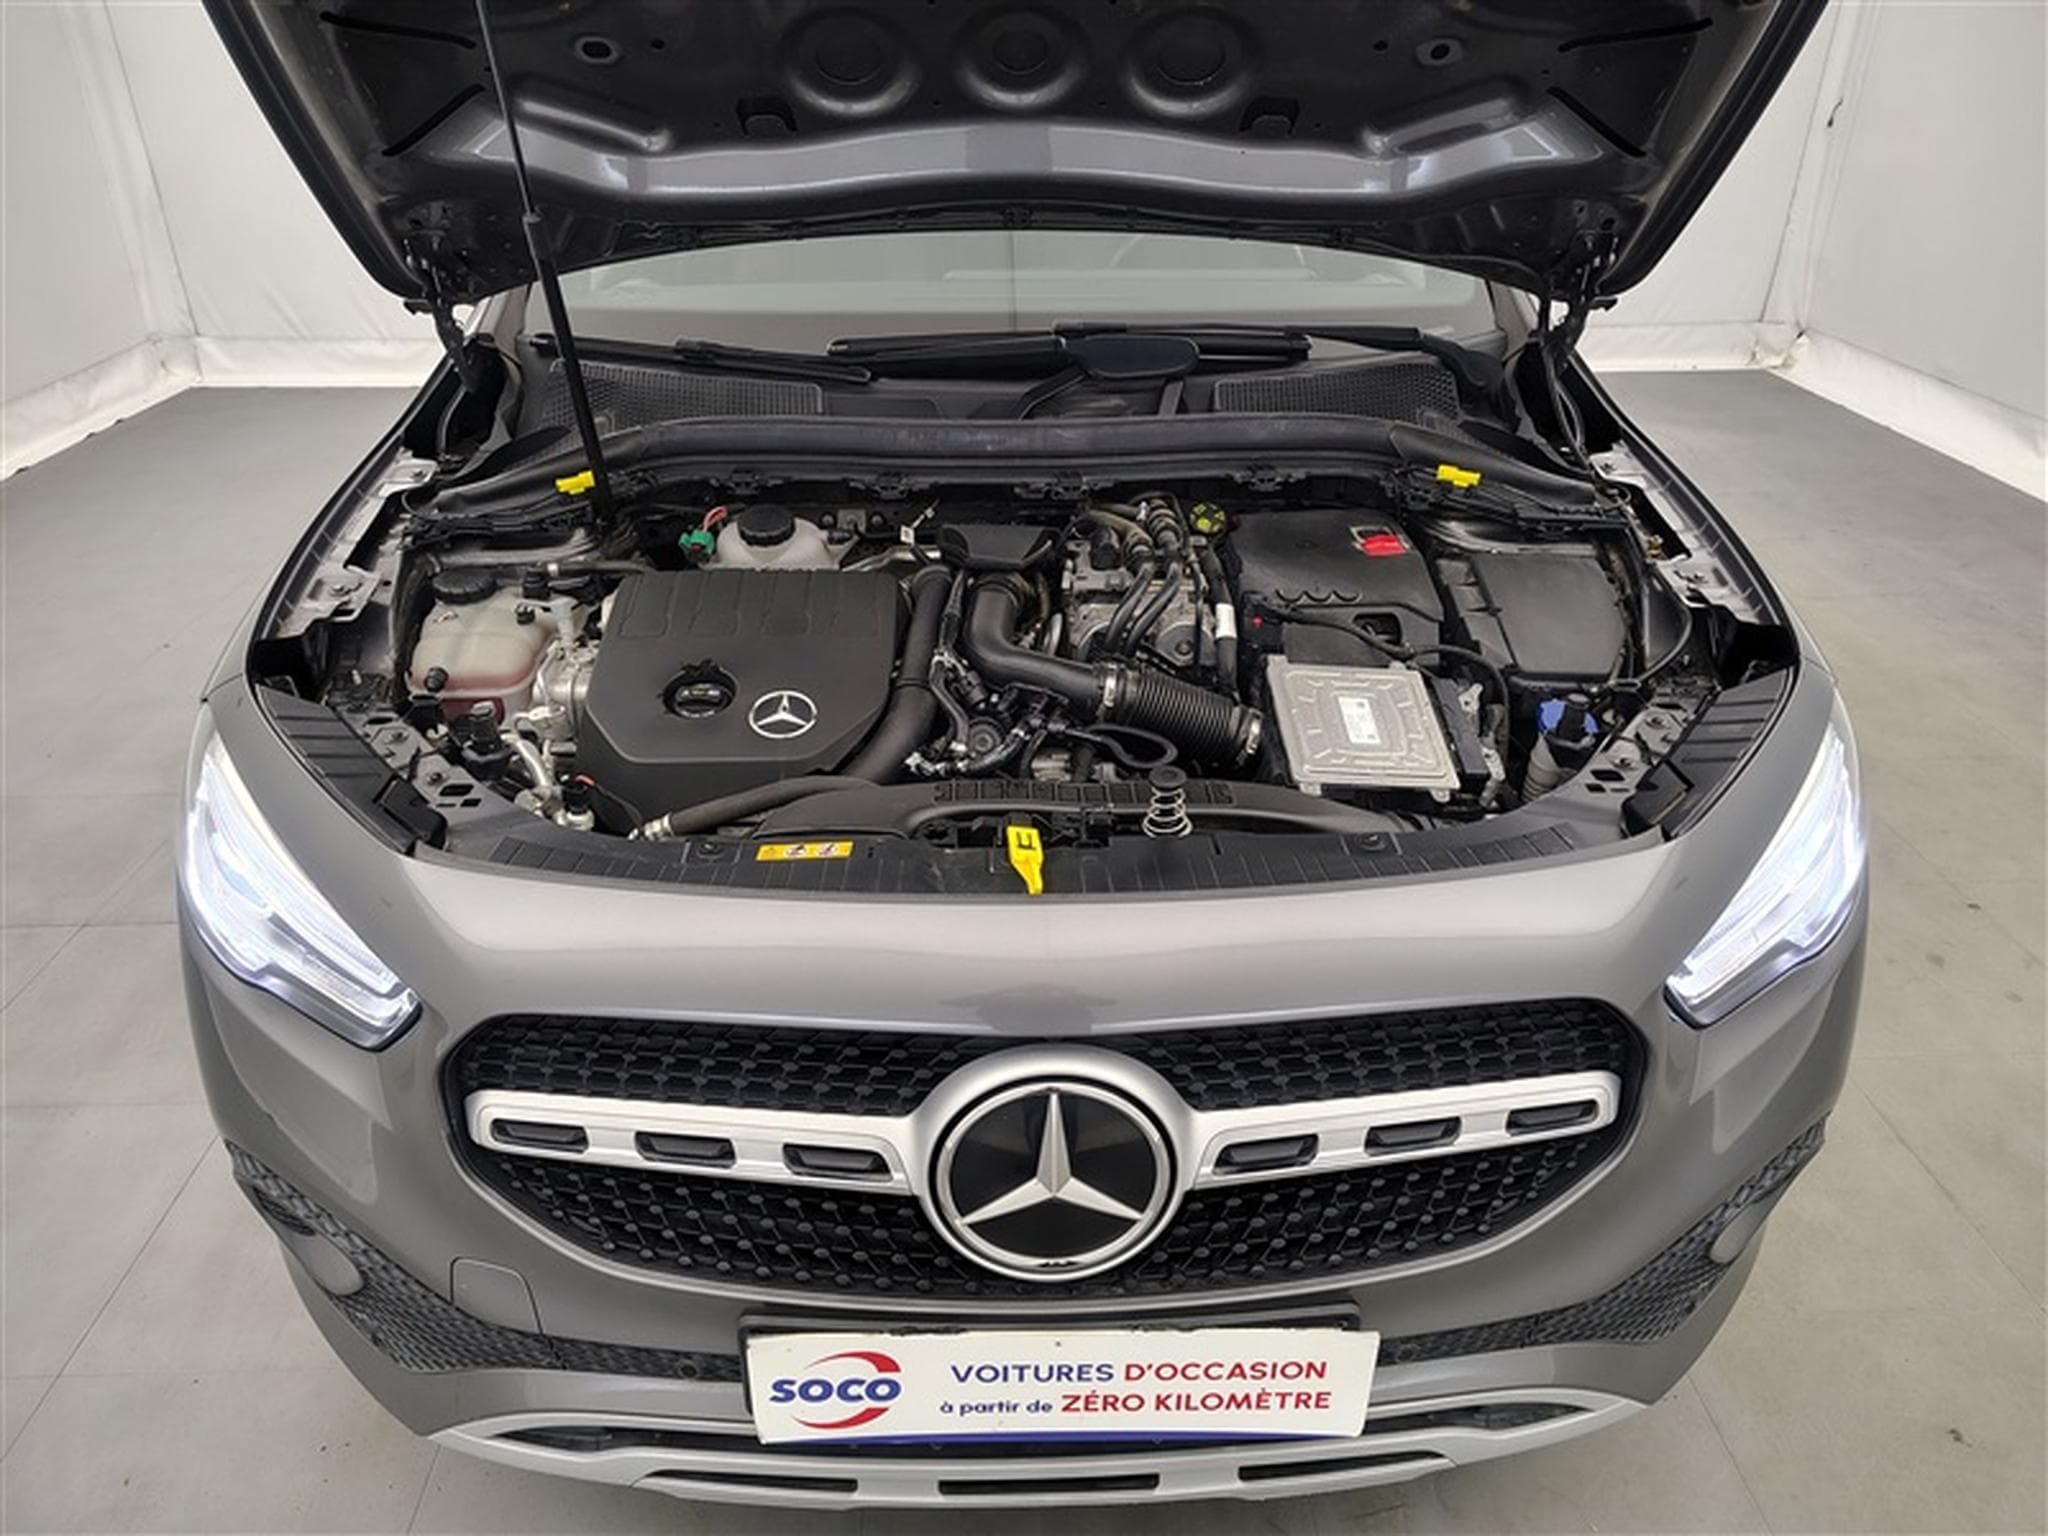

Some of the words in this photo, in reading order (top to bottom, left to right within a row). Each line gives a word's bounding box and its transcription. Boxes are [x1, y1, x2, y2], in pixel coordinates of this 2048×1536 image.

[952, 1364, 1114, 1383] VOITURES
[1125, 1362, 1327, 1382] D'OCCASION
[770, 1376, 901, 1404] SOCO
[940, 1399, 954, 1414] à
[960, 1400, 1019, 1417] partir
[1026, 1399, 1053, 1413] de
[1062, 1388, 1146, 1413] ZÉRO
[1155, 1387, 1332, 1412] KILOMÈTRE
